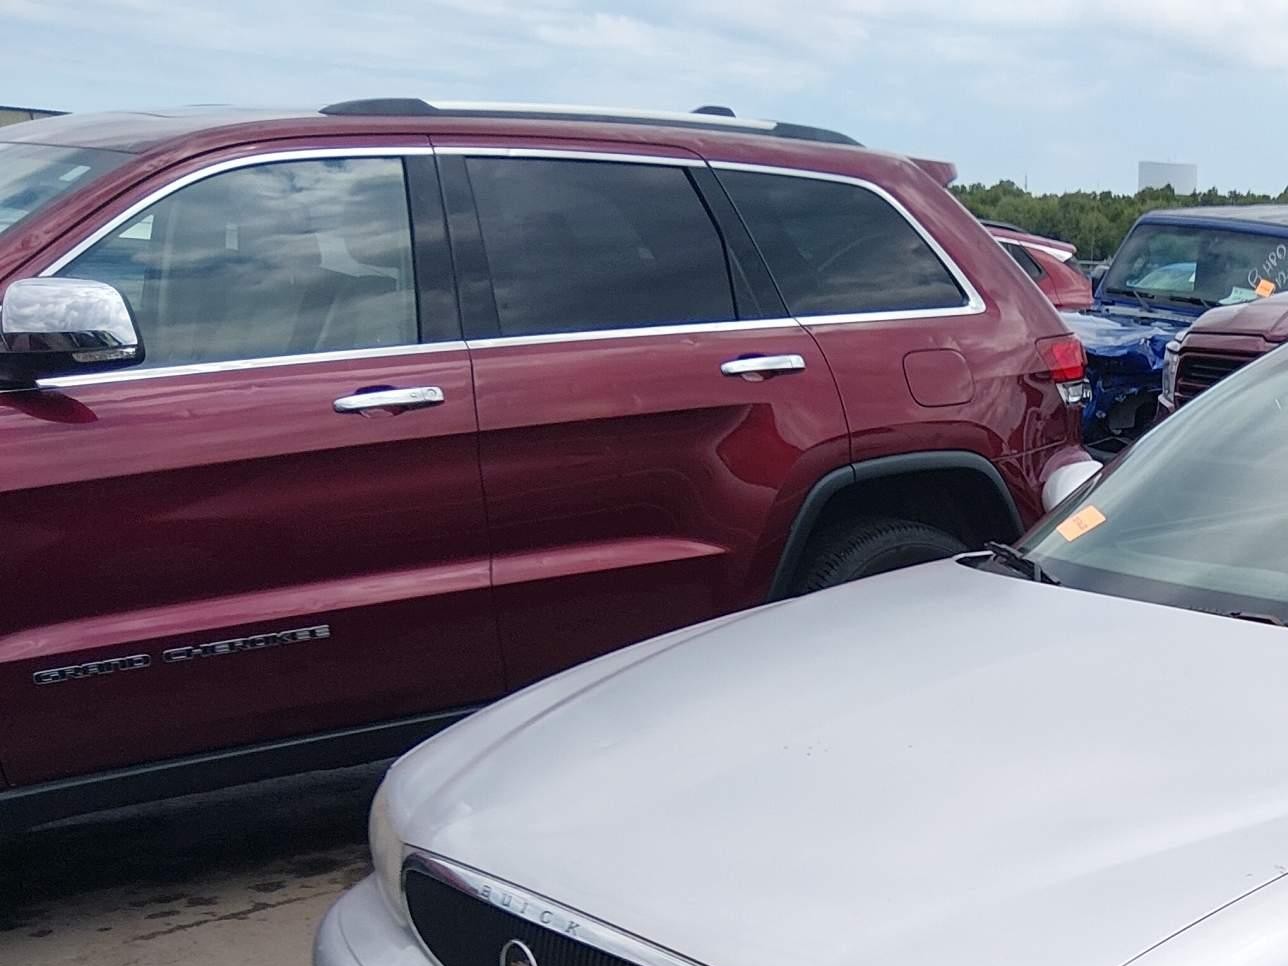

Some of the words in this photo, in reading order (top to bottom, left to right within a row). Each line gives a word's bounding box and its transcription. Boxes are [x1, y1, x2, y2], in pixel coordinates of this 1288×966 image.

[32, 654, 150, 685] GRAND
[162, 624, 330, 663] CHEROKEE
[480, 885, 580, 936] BUICK
